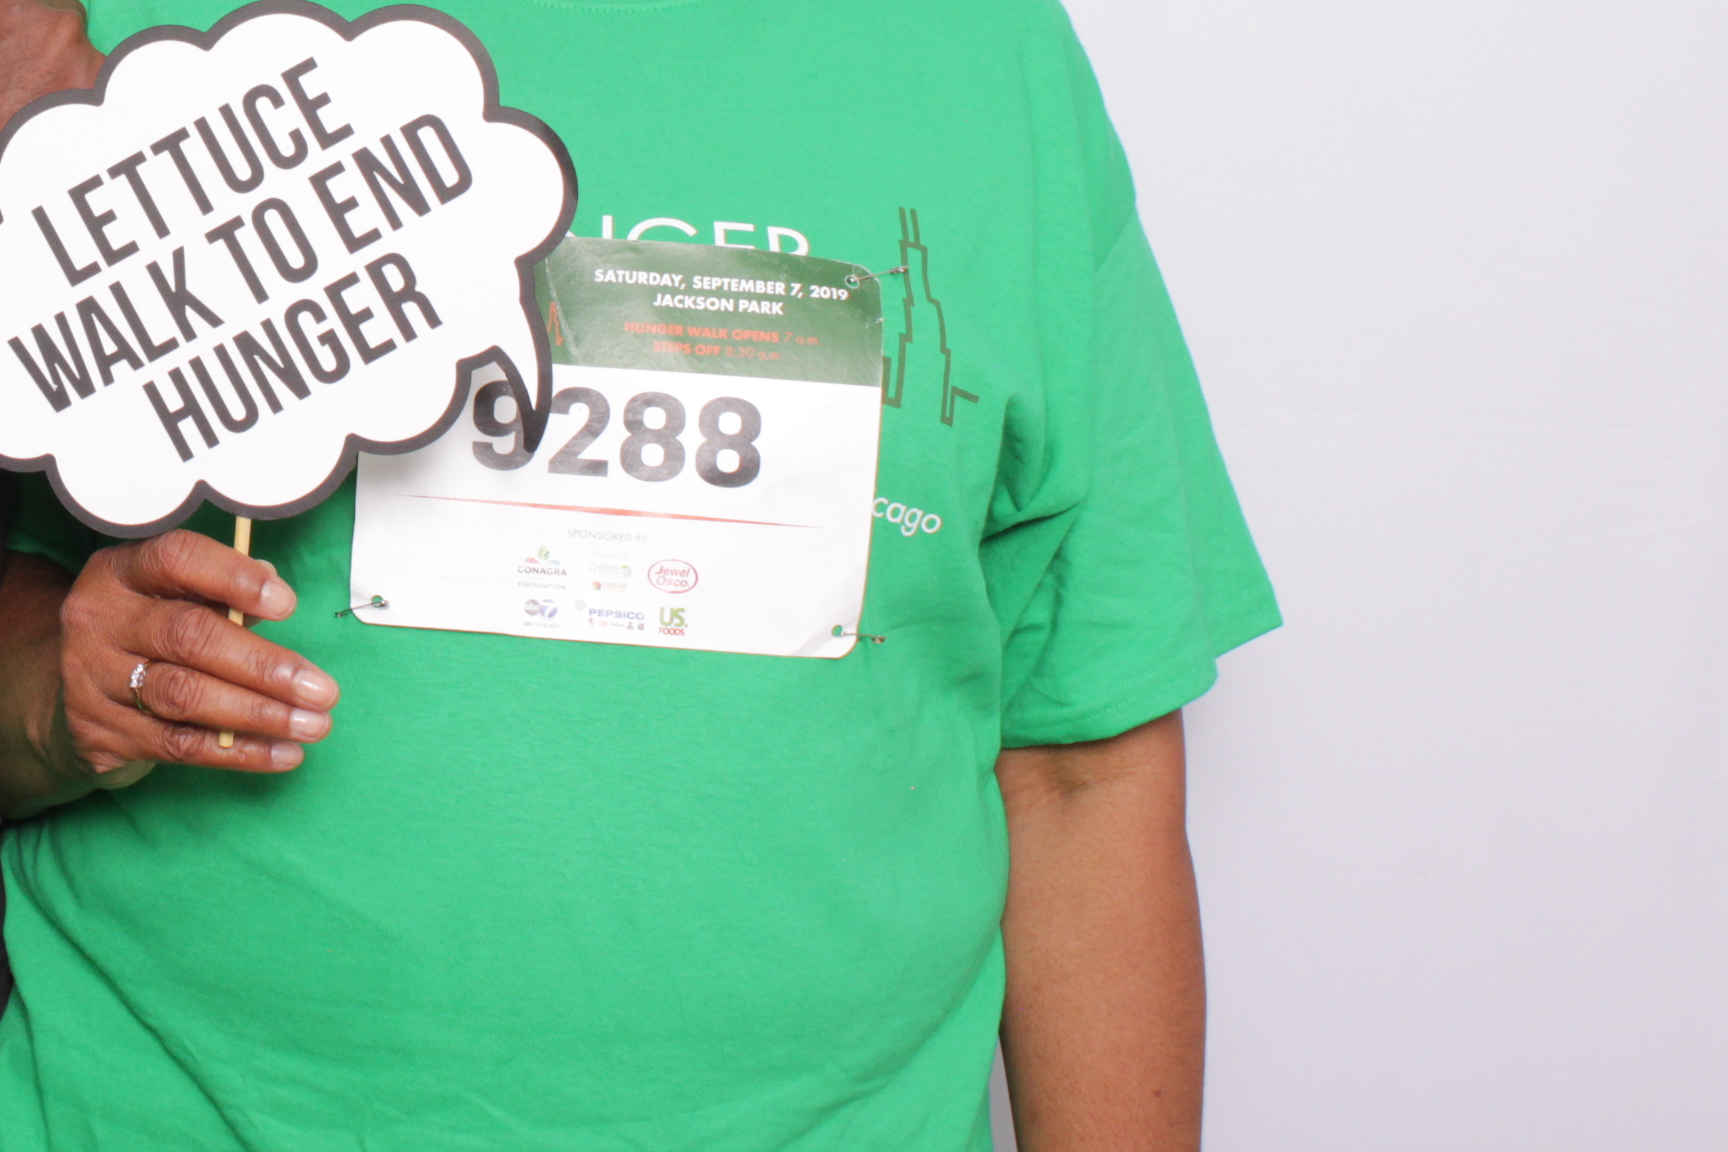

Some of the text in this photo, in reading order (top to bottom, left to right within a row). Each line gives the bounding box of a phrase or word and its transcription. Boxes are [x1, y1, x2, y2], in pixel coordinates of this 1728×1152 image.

[31, 56, 355, 287] LETTUCE
[7, 113, 473, 413] WALK TO END
[594, 268, 849, 301] SATURDAY, SEPTEMBER 7, 2019
[653, 293, 785, 316] JACKSON PARK
[624, 321, 822, 346] HUNGER WALK OPENS 7 a.m.
[142, 252, 444, 463] HUNGER
[653, 341, 692, 355] STEPS
[694, 344, 722, 357] OFF
[471, 379, 763, 489] 9288
[566, 528, 632, 543] SPONSORED
[517, 565, 568, 577] CONAGRA
[654, 565, 690, 578] Jewel
[518, 580, 566, 591] FOUNDATION
[588, 608, 645, 621] PEPSICO
[658, 626, 685, 637] FOODS
